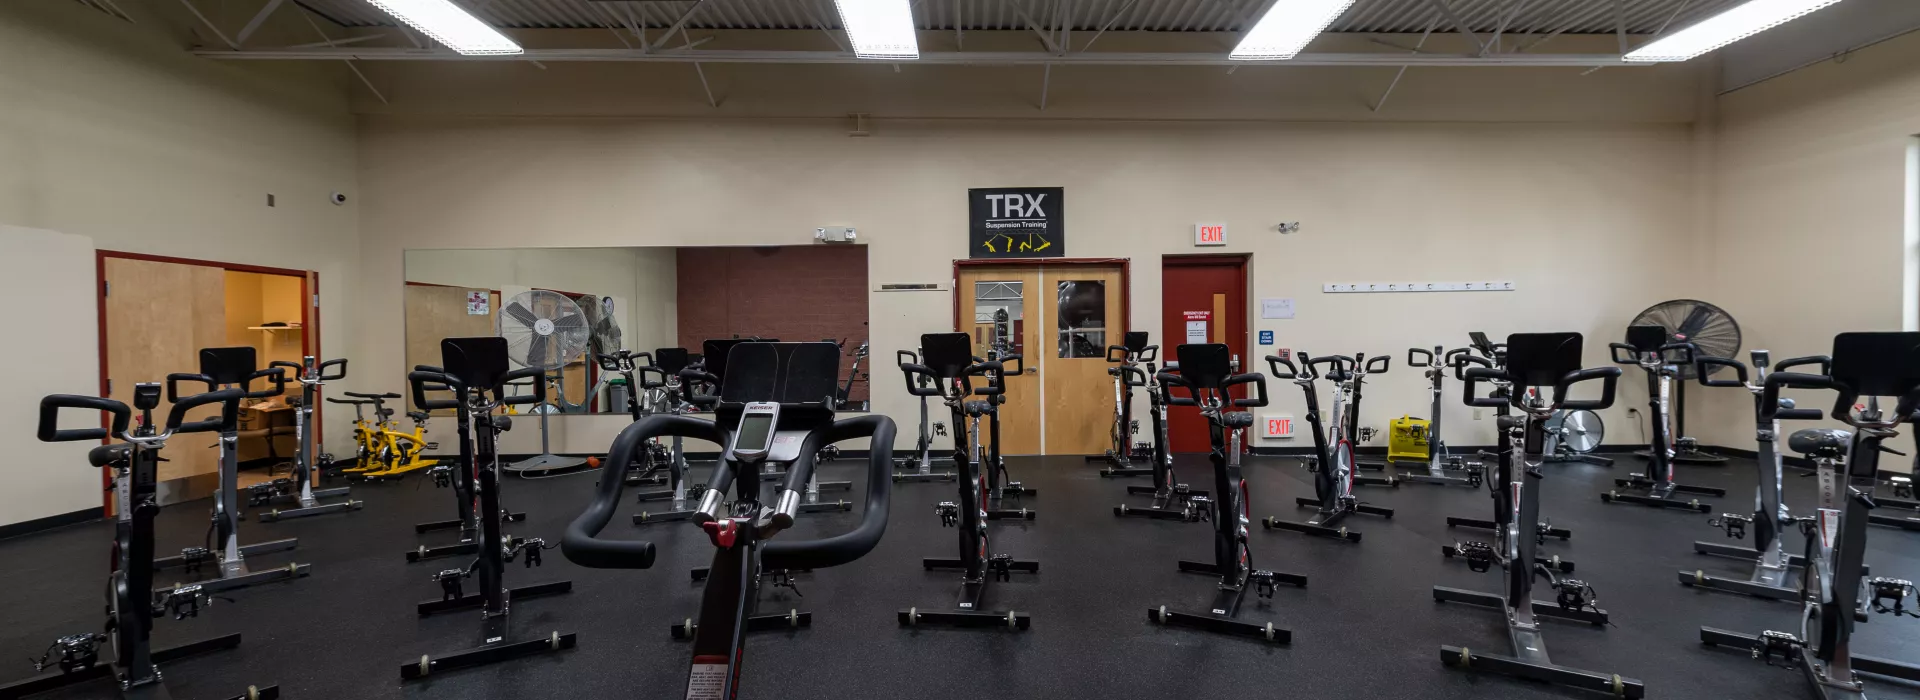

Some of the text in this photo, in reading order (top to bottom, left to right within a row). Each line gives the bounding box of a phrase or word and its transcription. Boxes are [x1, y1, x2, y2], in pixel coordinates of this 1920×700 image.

[985, 193, 1046, 218] TRX
[1021, 221, 1047, 229] Training
[1201, 226, 1223, 242] EXIT
[1269, 419, 1290, 434] EXIT
